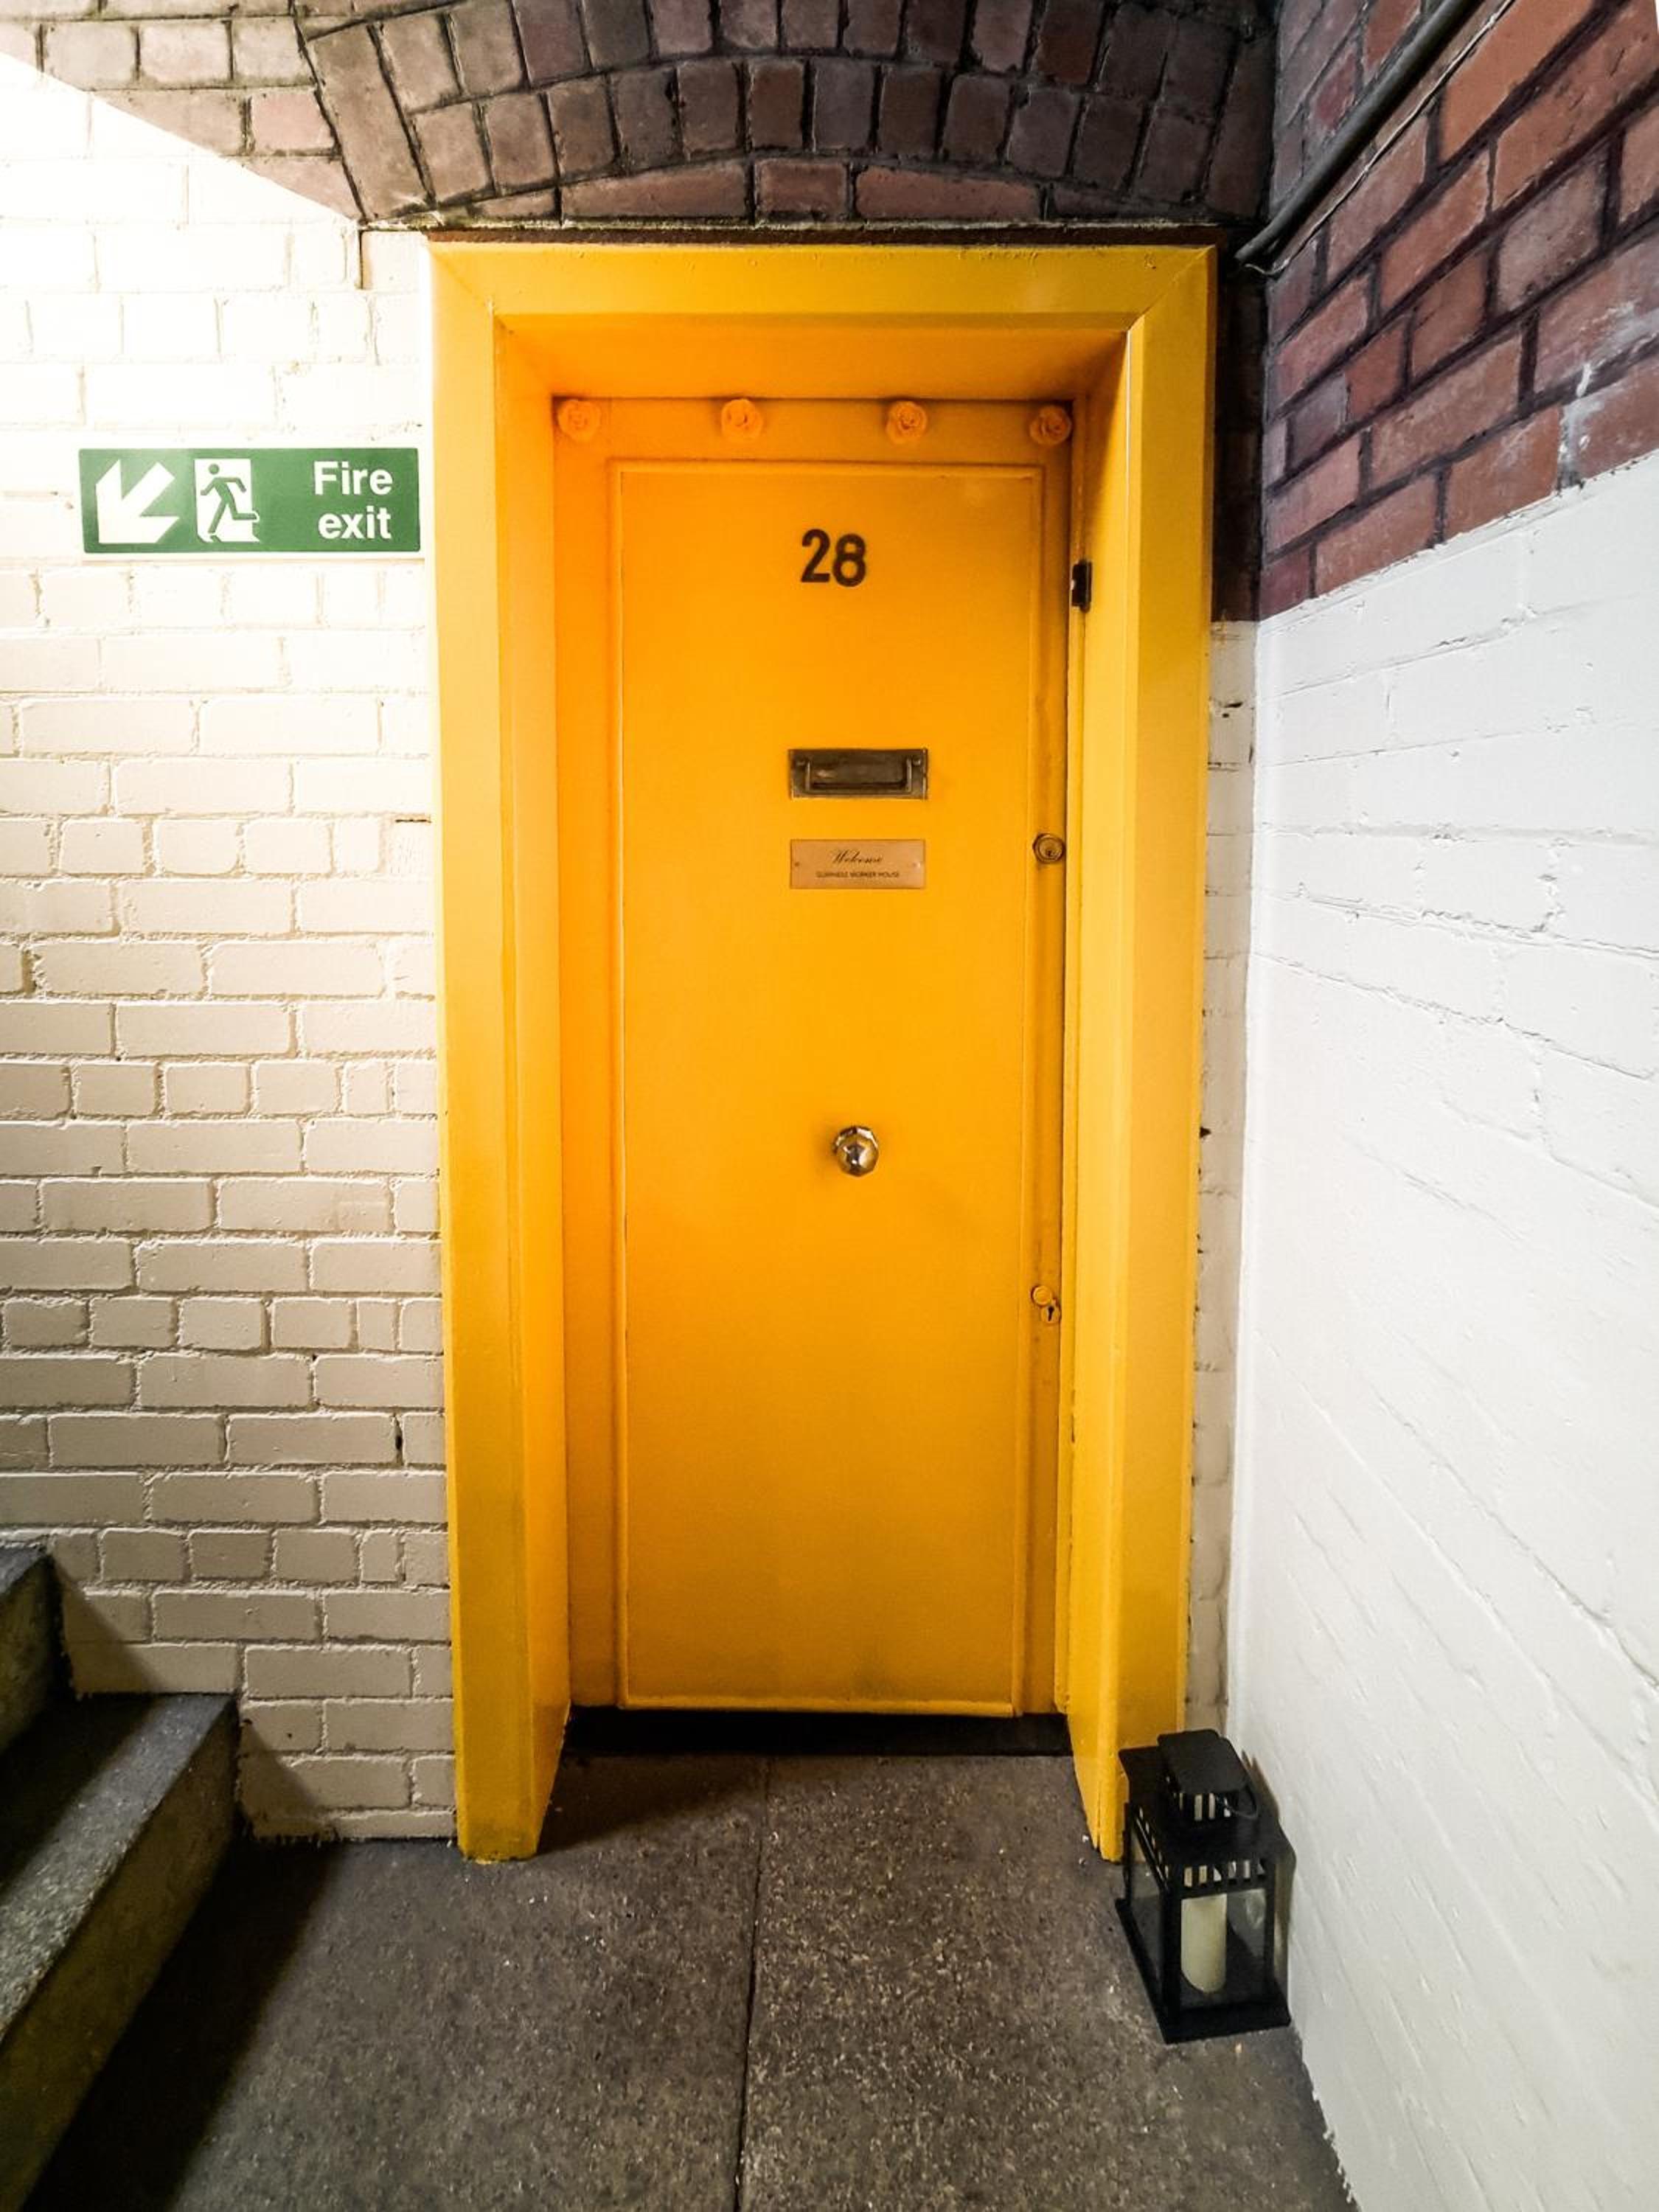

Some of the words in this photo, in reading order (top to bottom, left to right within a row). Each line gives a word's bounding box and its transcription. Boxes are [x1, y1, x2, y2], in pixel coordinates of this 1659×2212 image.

[314, 461, 393, 495] Fire
[318, 506, 392, 539] exit
[801, 529, 866, 587] 28
[832, 849, 883, 863] Welcome
